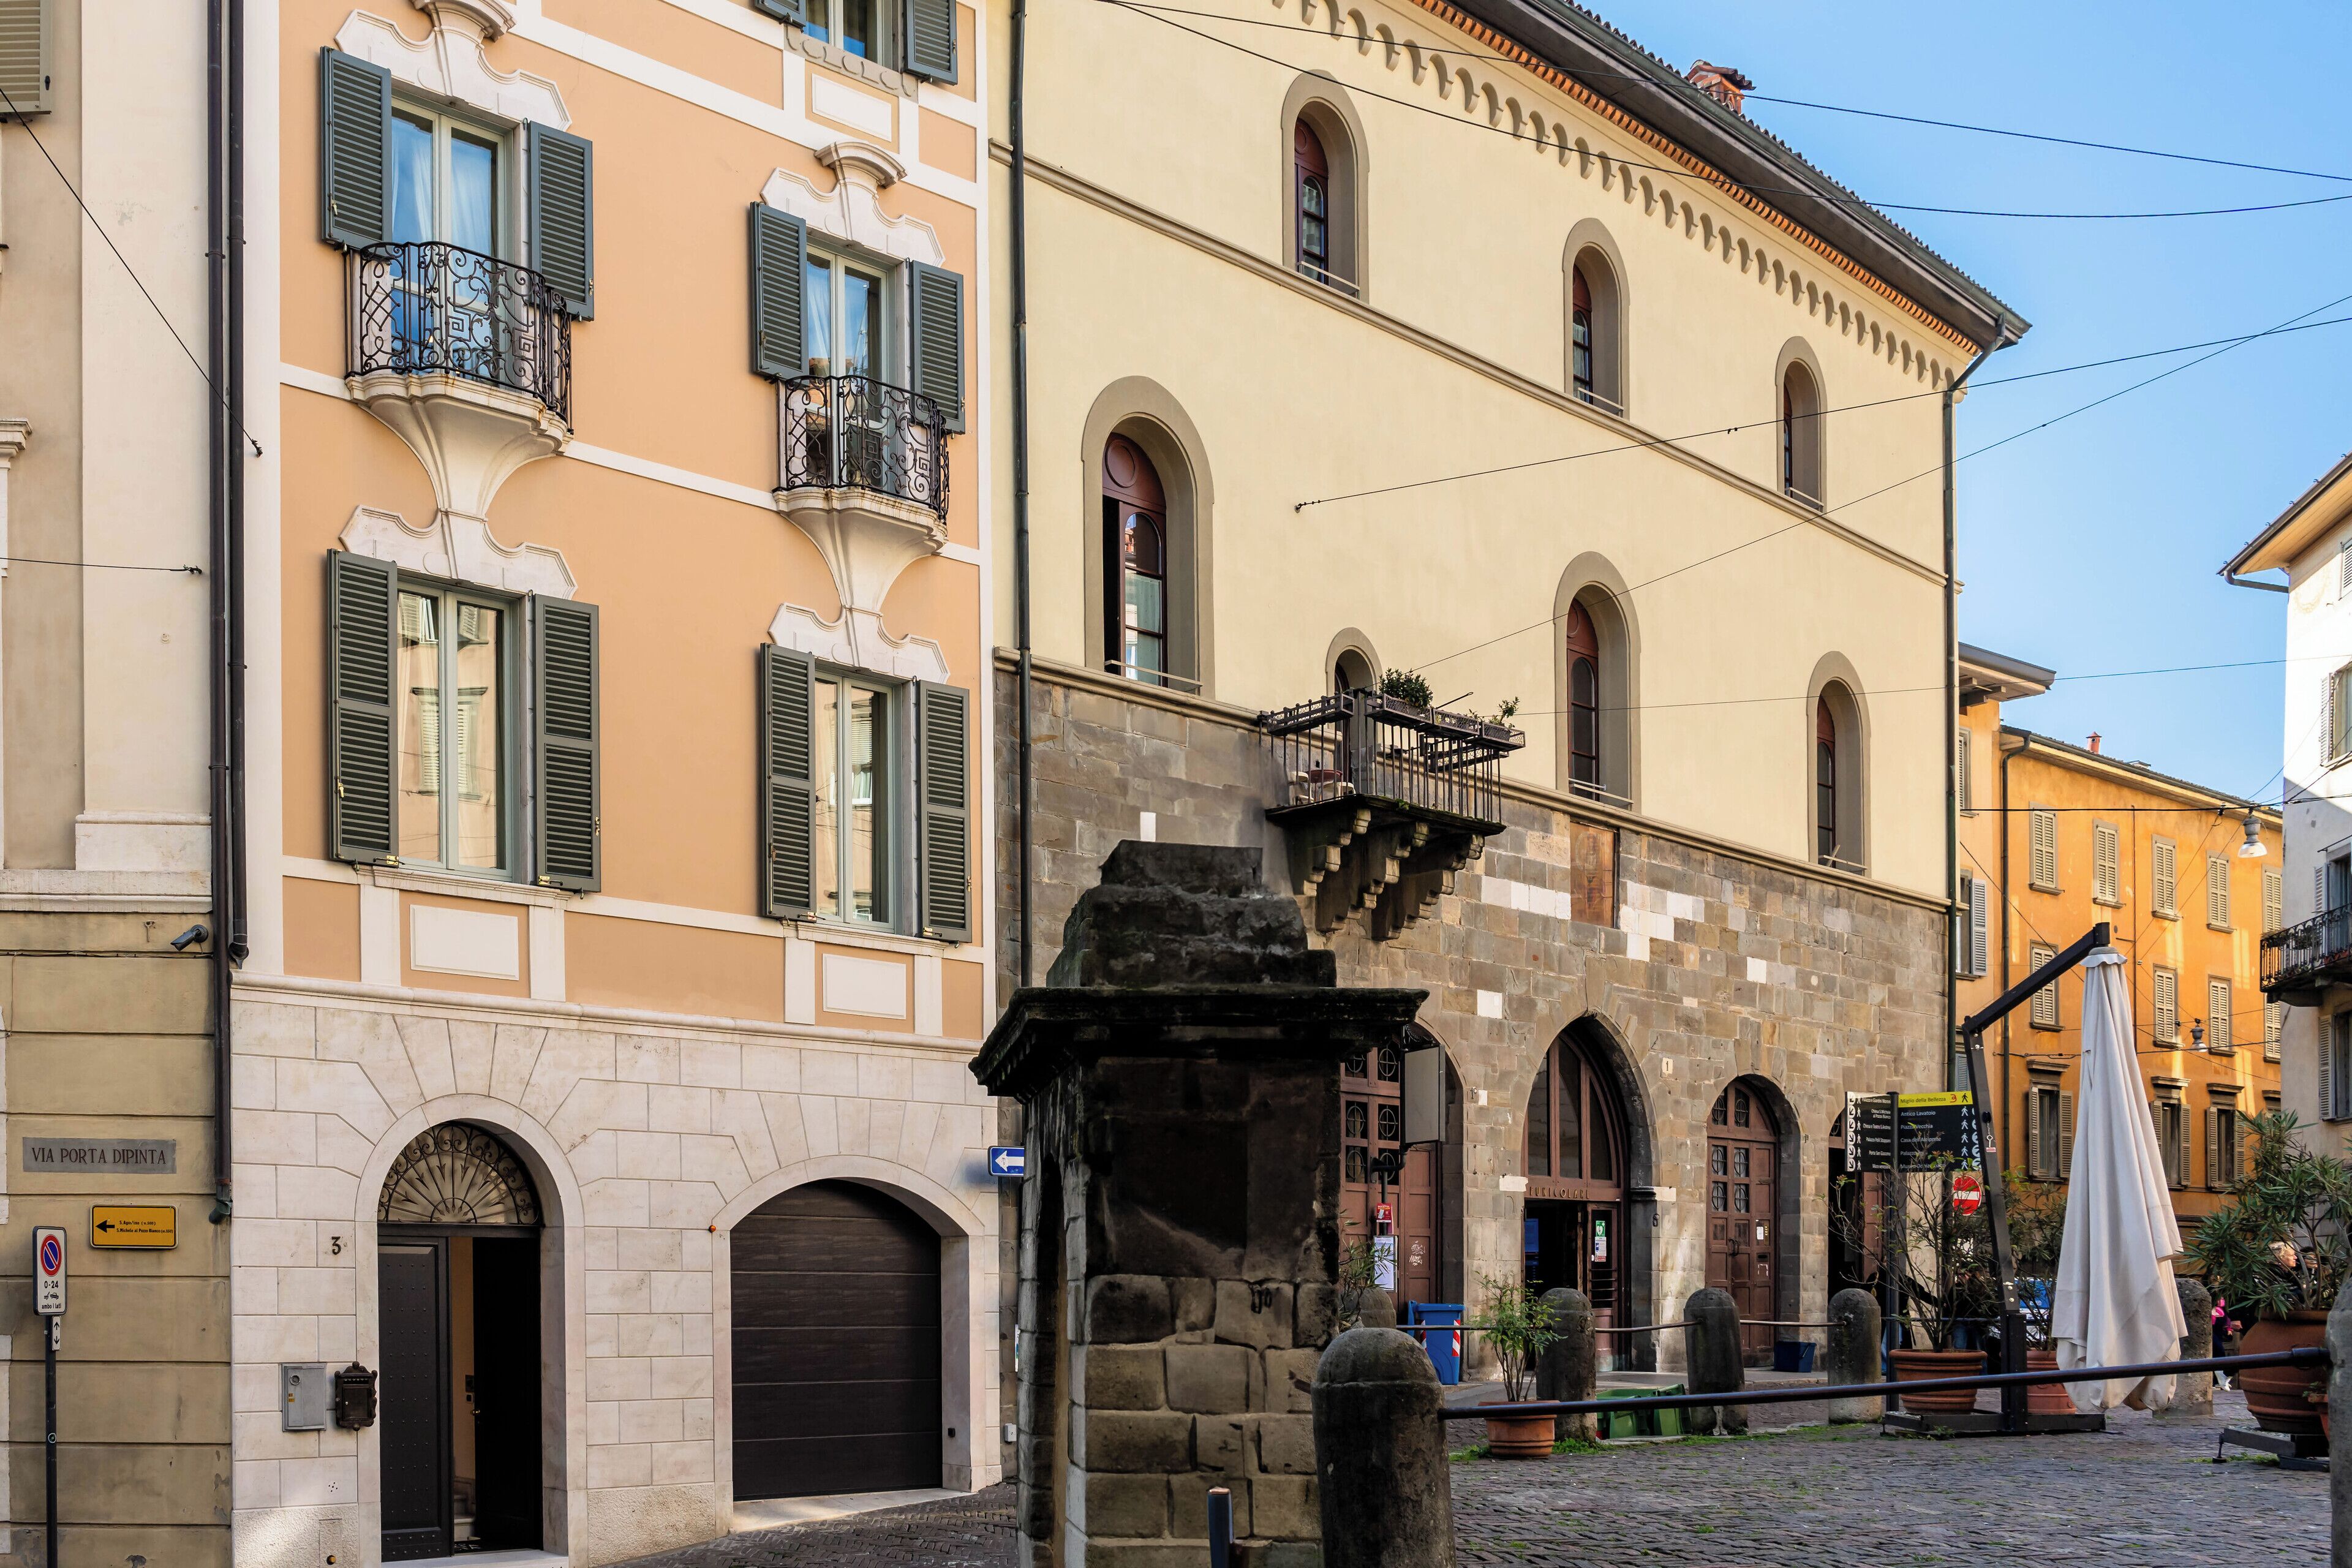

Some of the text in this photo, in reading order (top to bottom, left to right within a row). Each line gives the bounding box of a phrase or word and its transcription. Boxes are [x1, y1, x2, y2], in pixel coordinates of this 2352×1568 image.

[31, 1147, 167, 1164] VIA PORTA DIPINTA
[1529, 1186, 1590, 1199] FUNICOLARE
[331, 1236, 342, 1256] 3
[44, 1280, 59, 1289] 0-24
